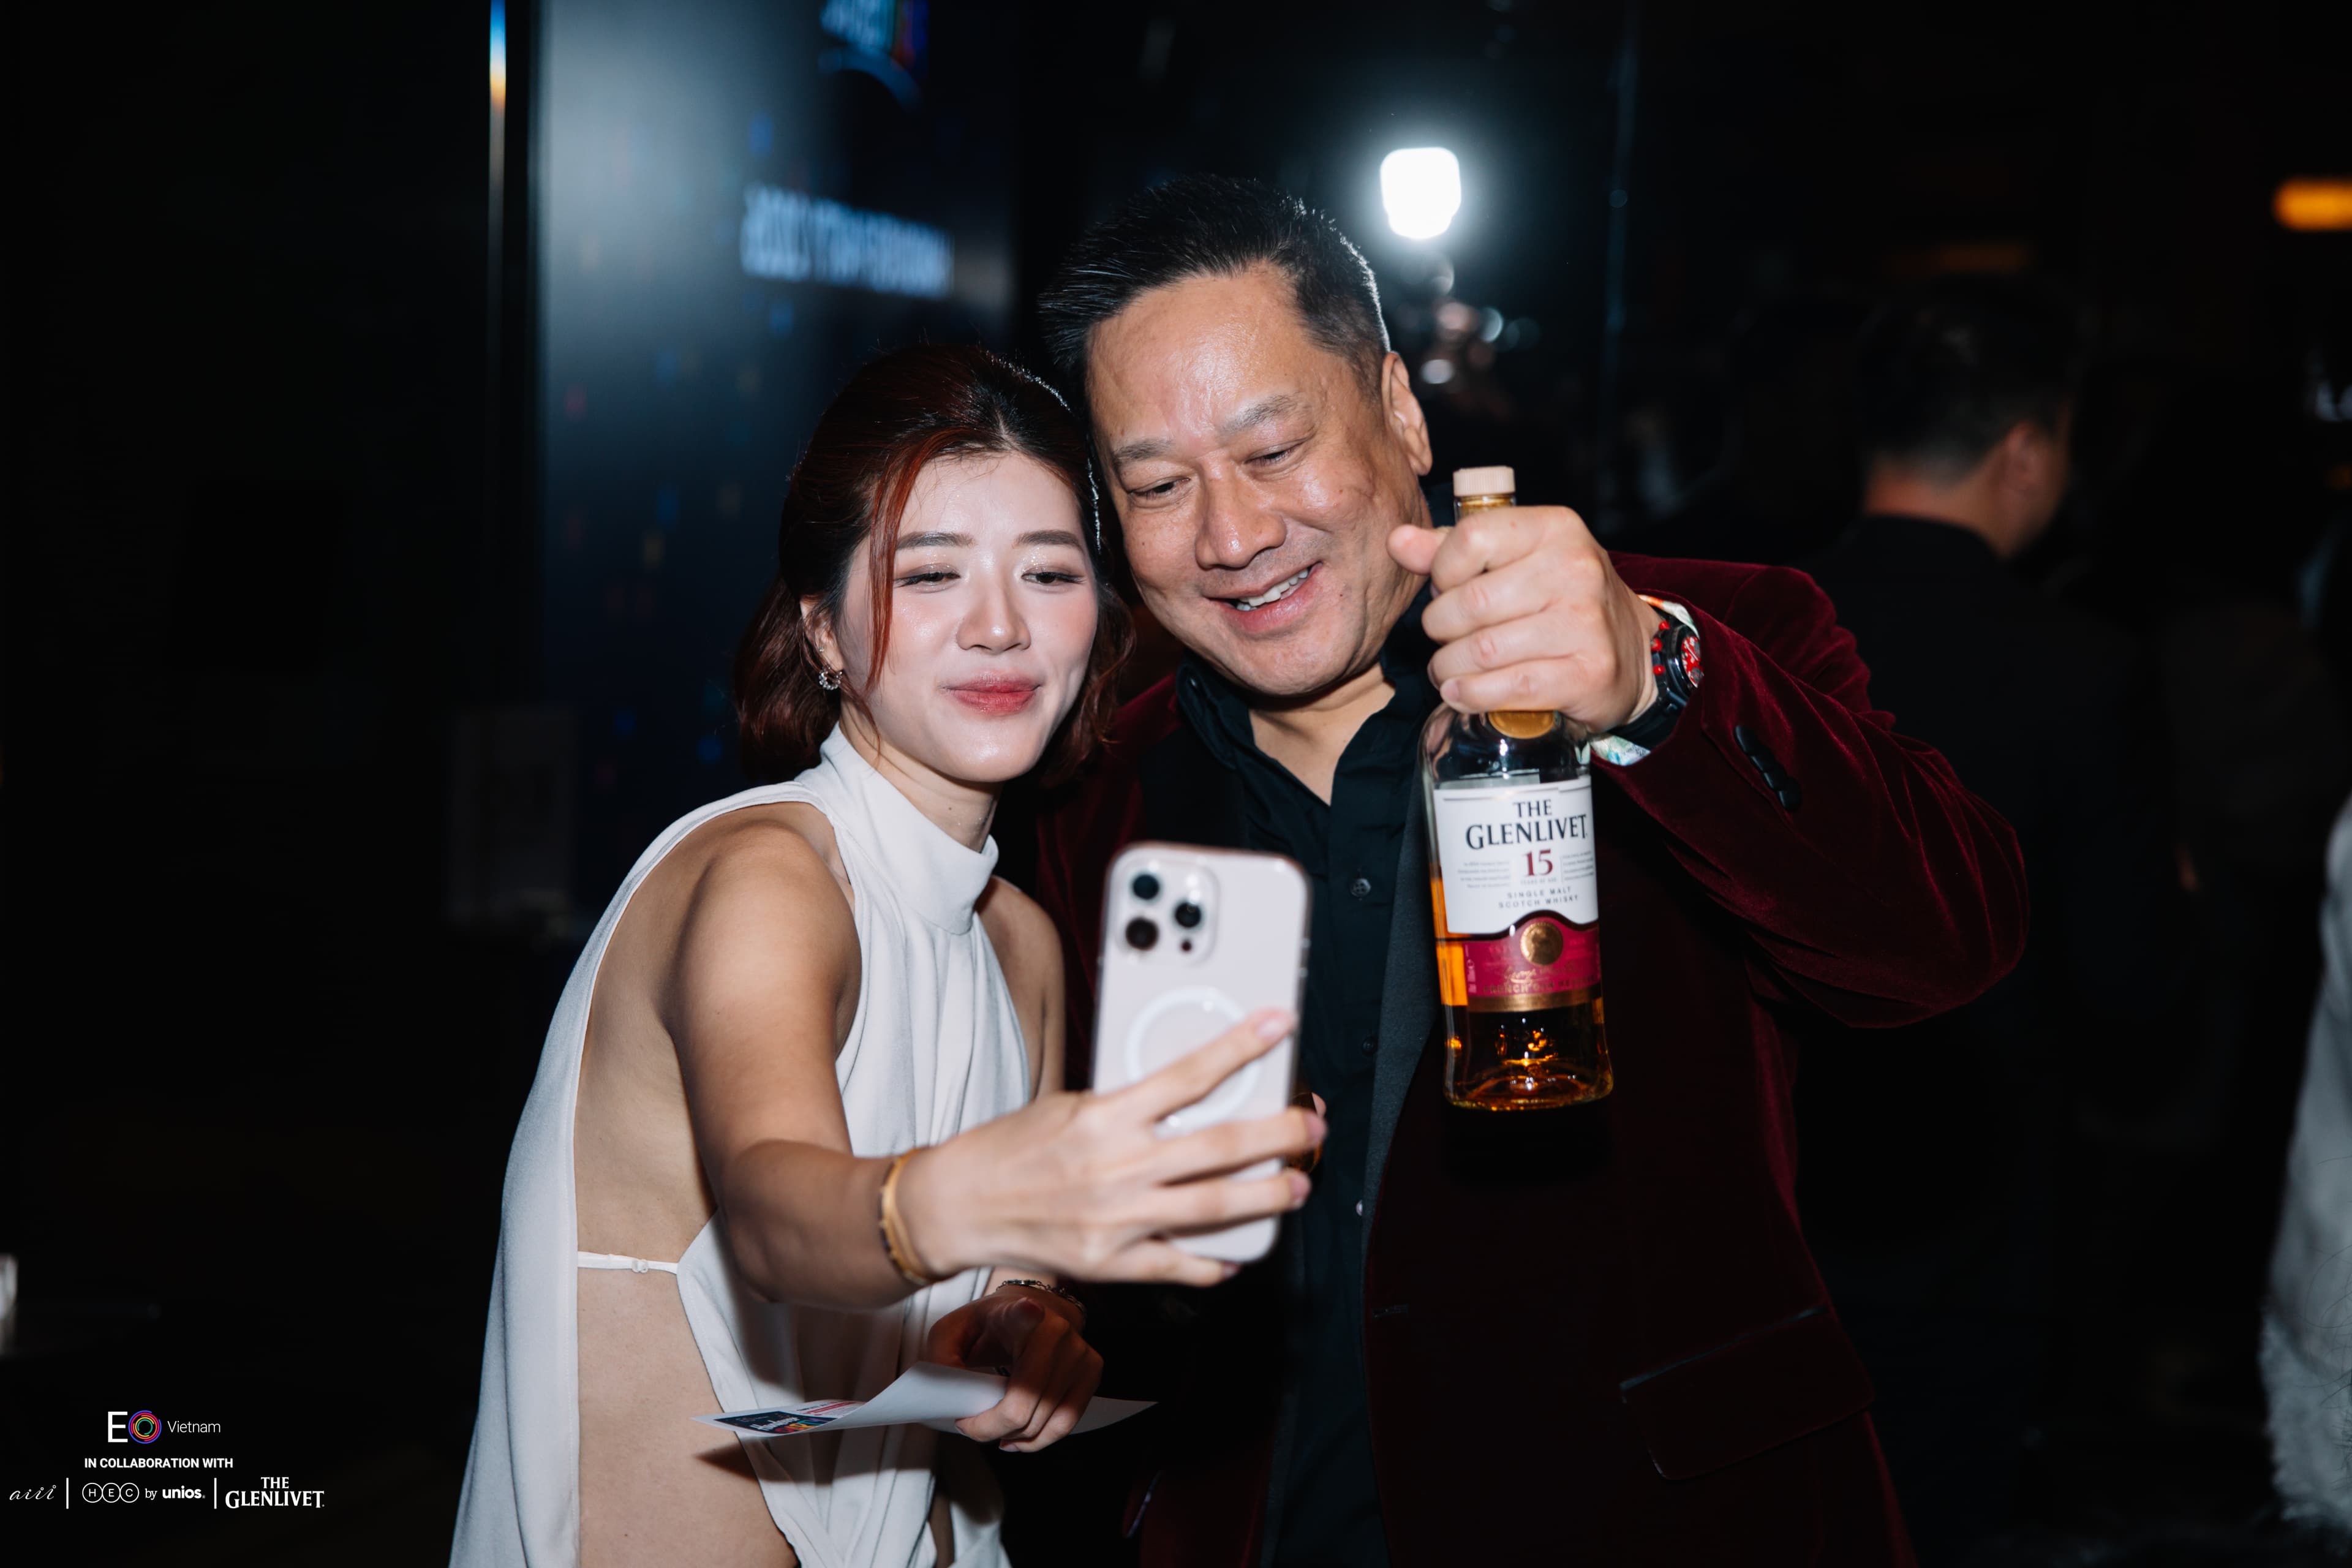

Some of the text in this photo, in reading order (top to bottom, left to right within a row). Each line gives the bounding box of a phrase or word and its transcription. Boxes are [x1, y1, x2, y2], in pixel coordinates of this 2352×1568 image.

[1513, 799, 1552, 818] THE
[1466, 814, 1587, 850] GLENLIVET
[1523, 849, 1553, 876] 15
[1499, 895, 1578, 908] SCOTCH WHISKY
[1507, 889, 1544, 899] SINGLE
